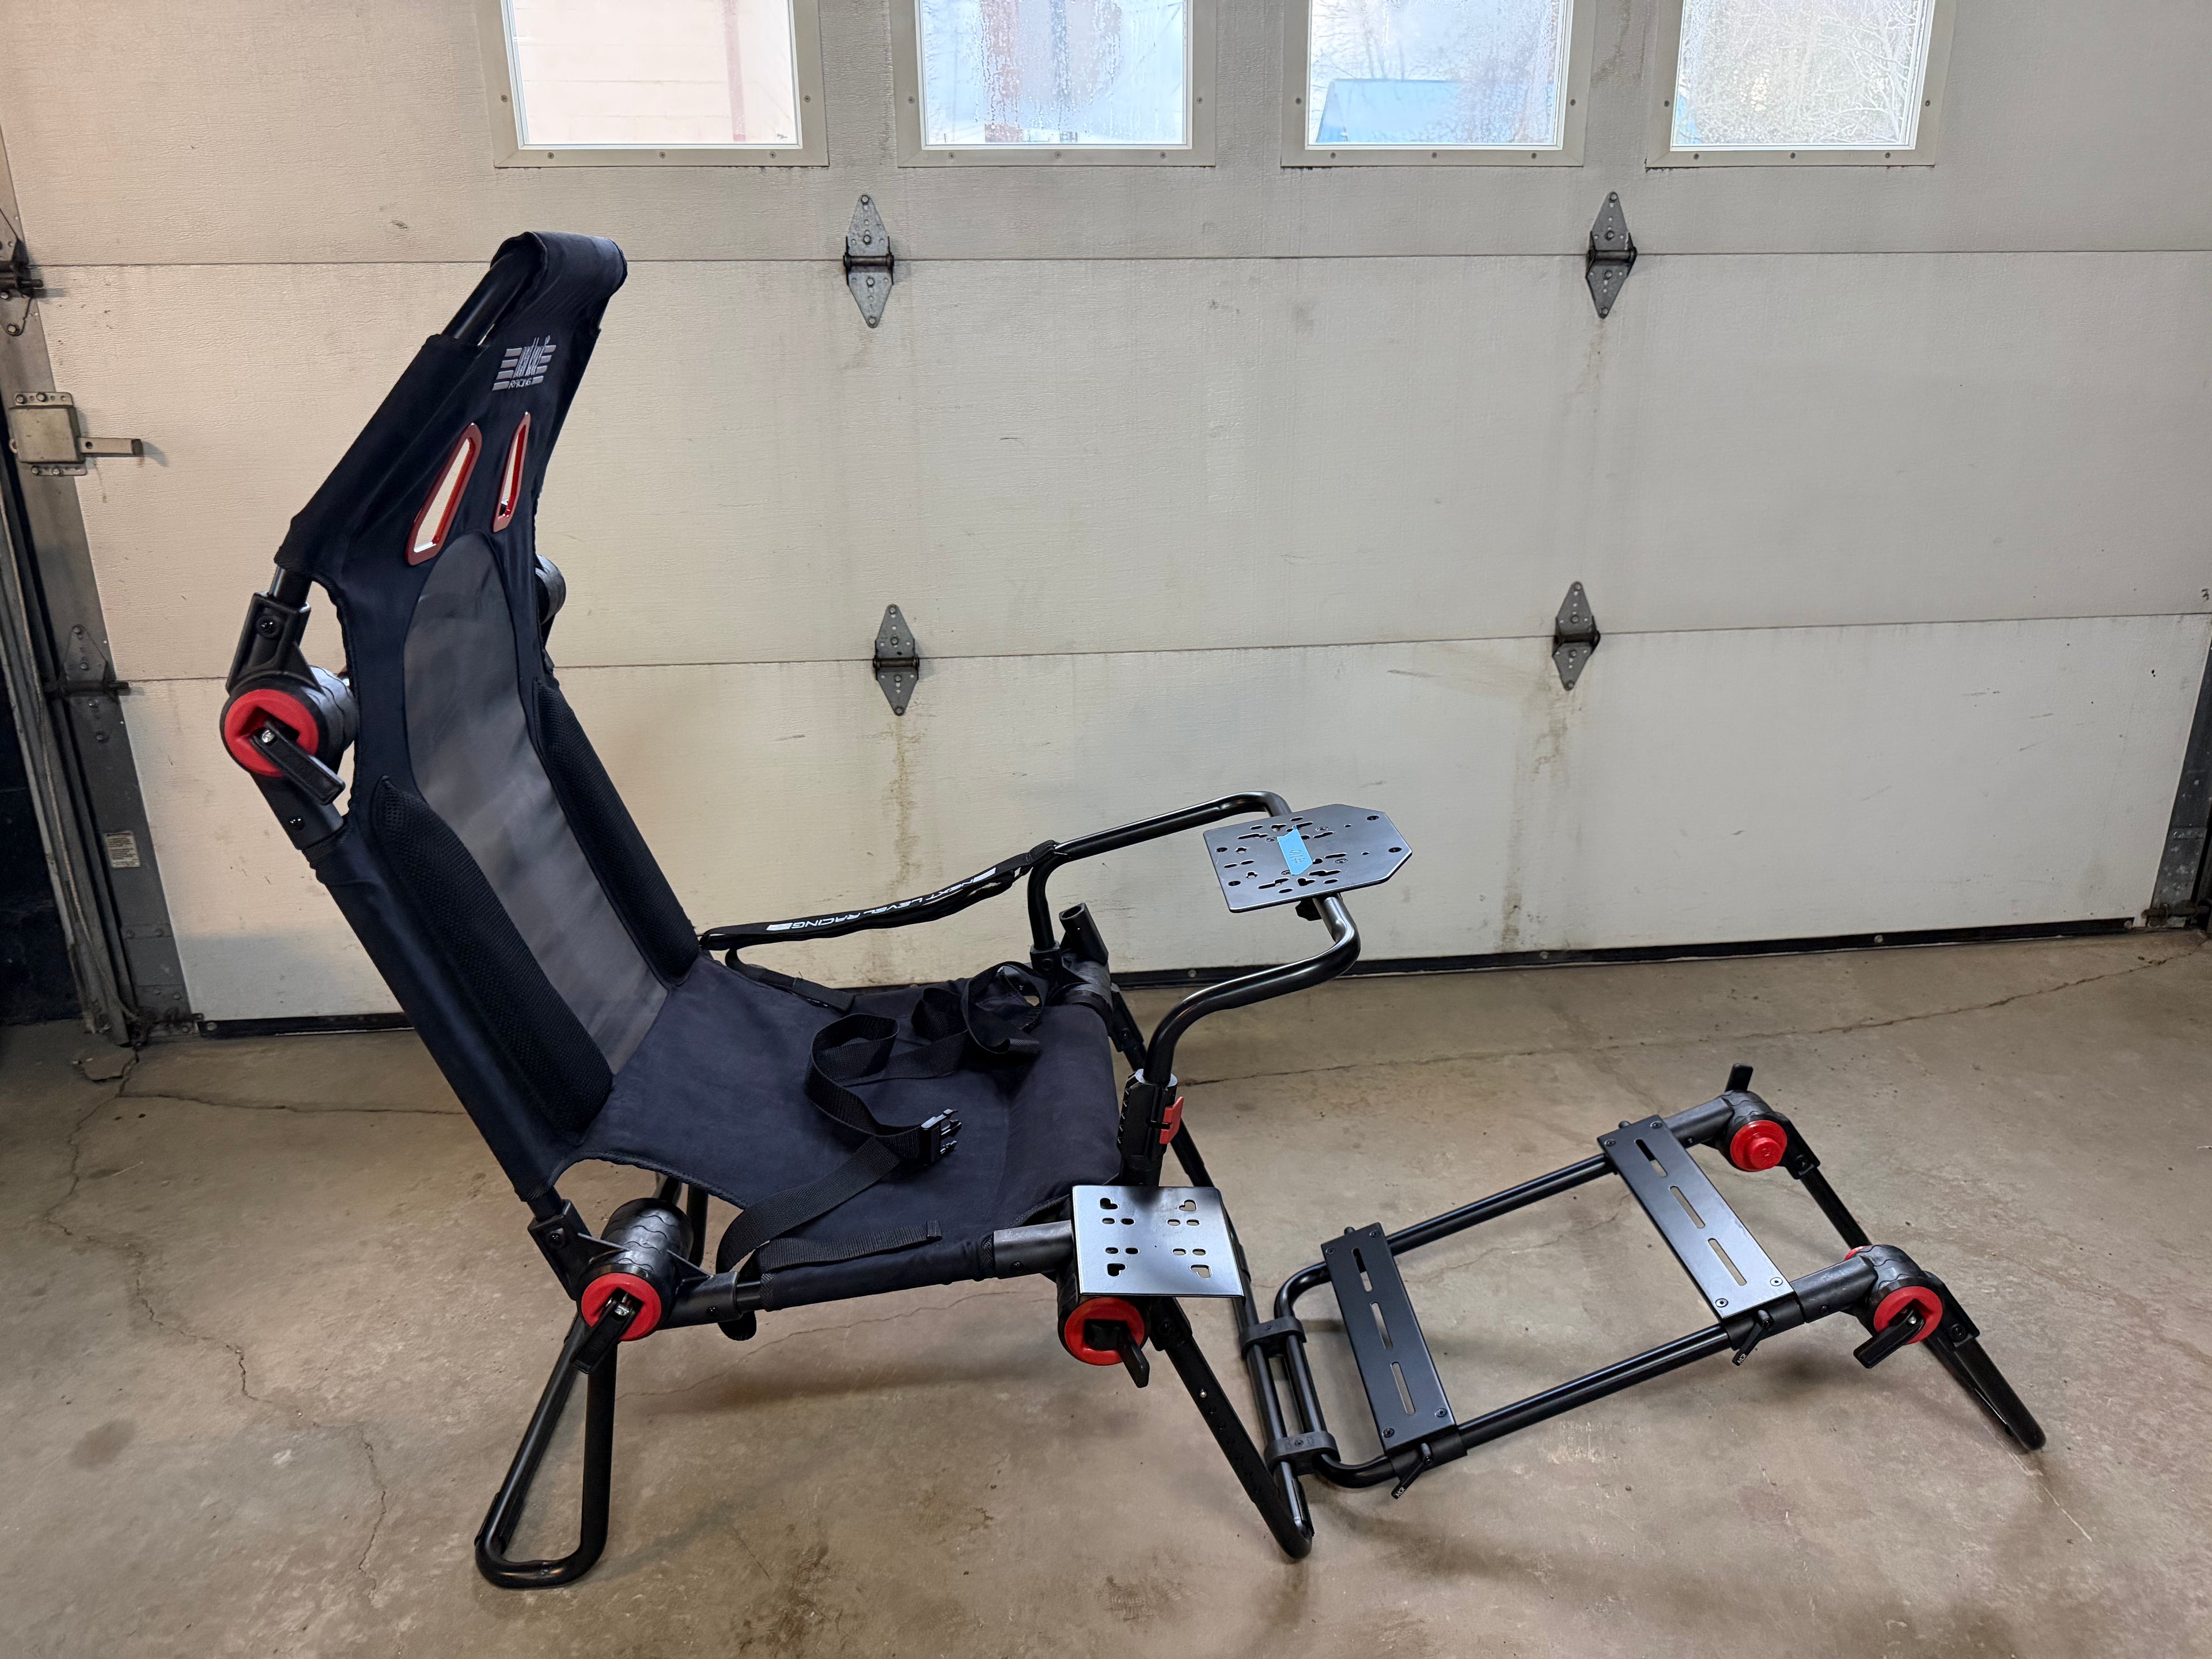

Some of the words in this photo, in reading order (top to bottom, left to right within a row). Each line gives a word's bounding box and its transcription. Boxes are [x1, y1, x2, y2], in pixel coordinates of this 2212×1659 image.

[926, 879, 974, 900] NEXT
[863, 897, 923, 914] LEVEL
[791, 912, 861, 929] RACING
